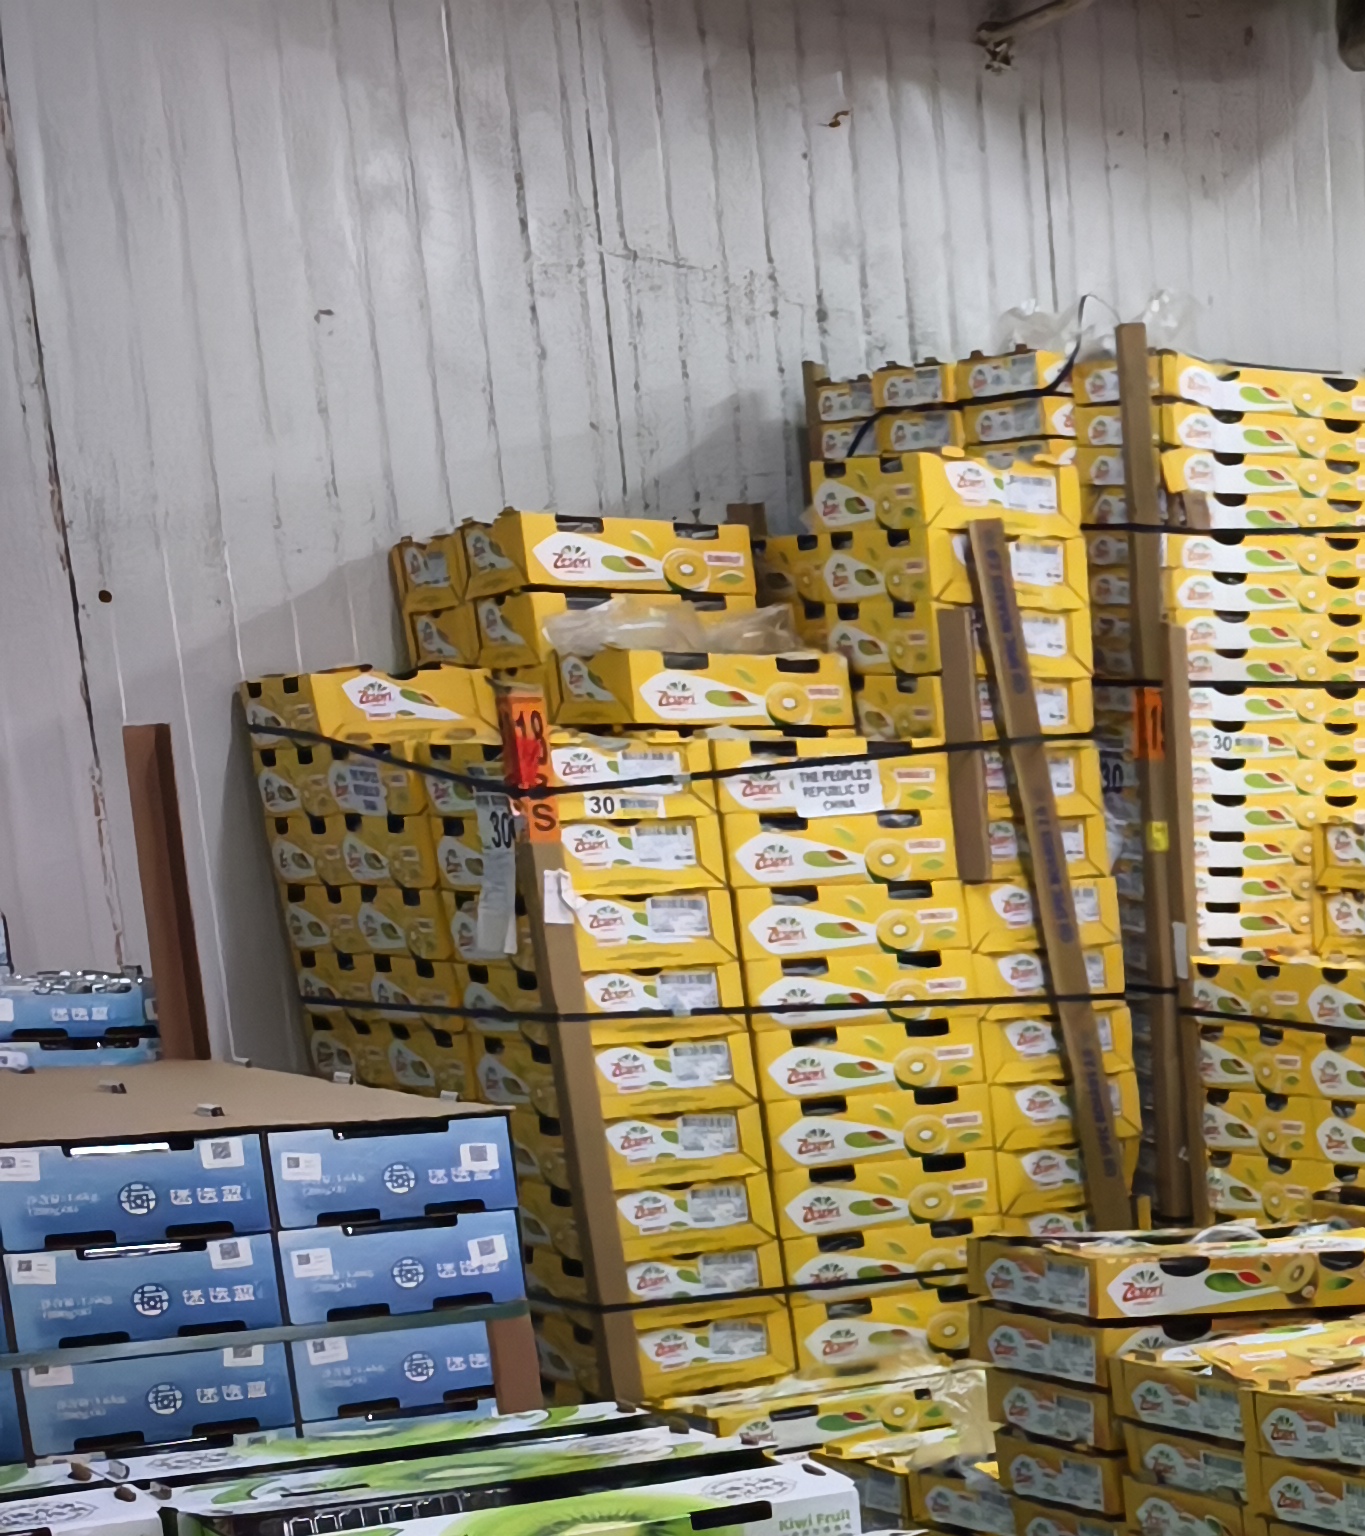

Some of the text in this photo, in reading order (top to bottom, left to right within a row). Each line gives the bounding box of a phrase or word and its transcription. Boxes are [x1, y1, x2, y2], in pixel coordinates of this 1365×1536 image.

[1213, 735, 1233, 752] 30
[590, 795, 615, 816] 30
[532, 803, 557, 832] S
[1121, 1282, 1164, 1303] Zespri
[779, 1509, 850, 1532] Kiwi Fruit
